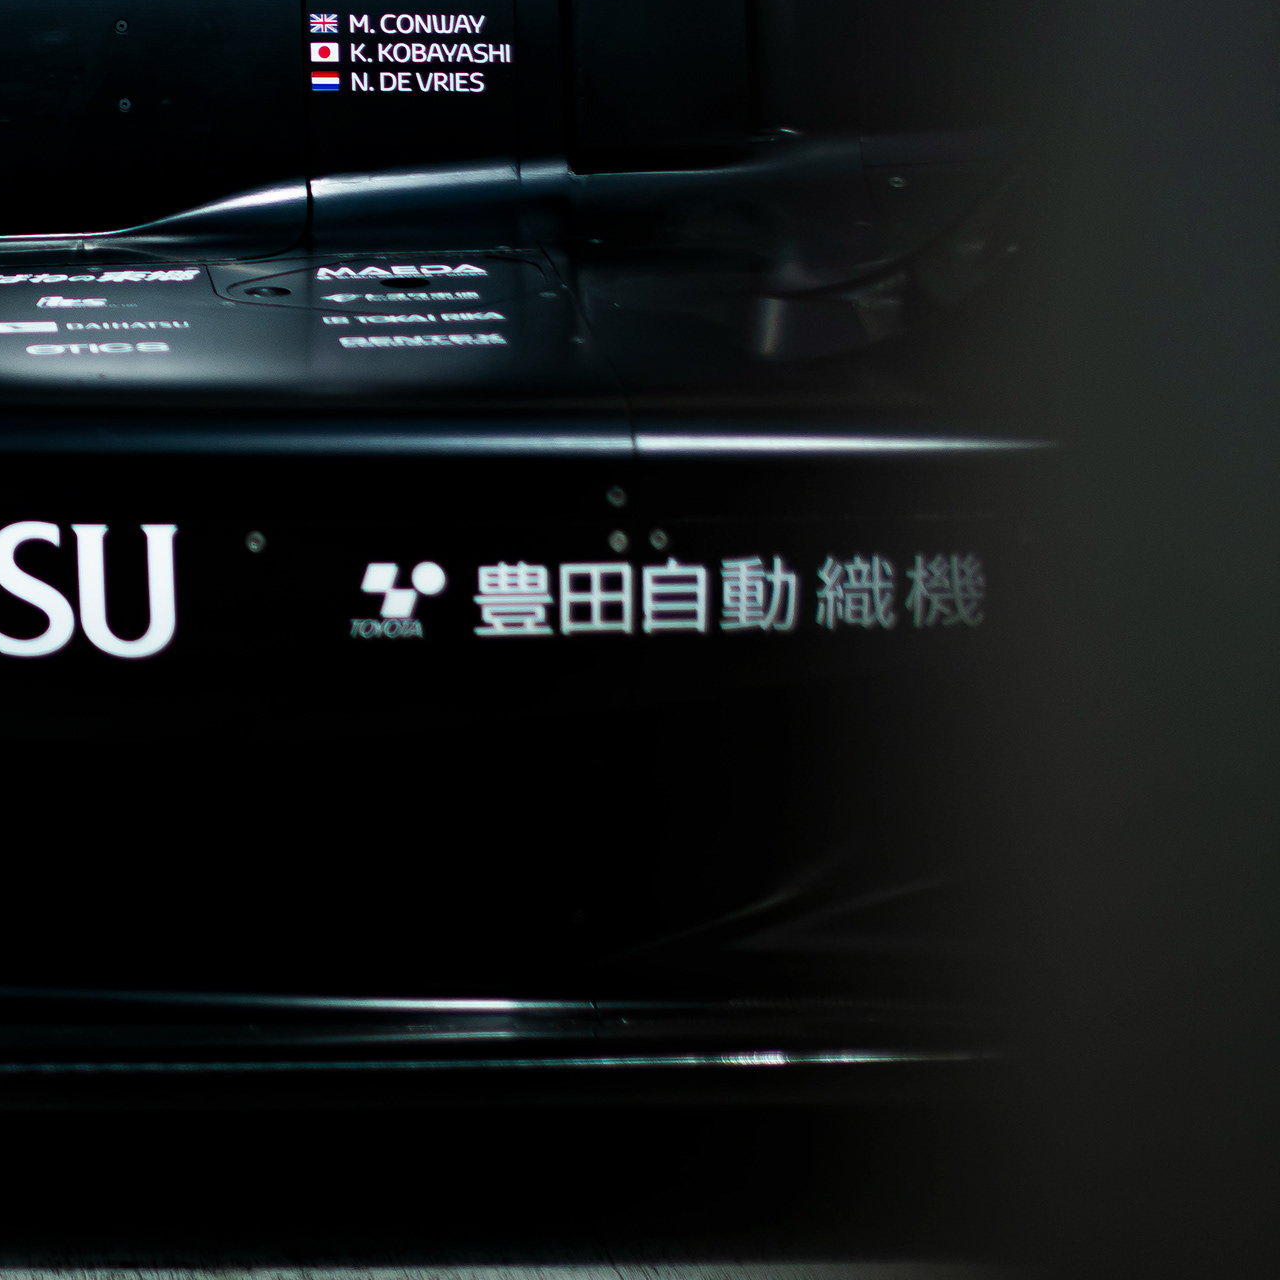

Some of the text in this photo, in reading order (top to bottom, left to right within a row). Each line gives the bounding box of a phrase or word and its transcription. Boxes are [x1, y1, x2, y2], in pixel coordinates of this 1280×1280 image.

[348, 14, 486, 34] M. CONWAY
[350, 43, 511, 64] K. KOBAYASHI
[351, 72, 486, 93] N. DE VRIES
[316, 263, 488, 277] MAEDA
[66, 320, 190, 330] DAIHATSU
[25, 341, 170, 355] OTICS
[472, 552, 987, 638] 豊田自動織機
[350, 618, 424, 639] TOYOTA
